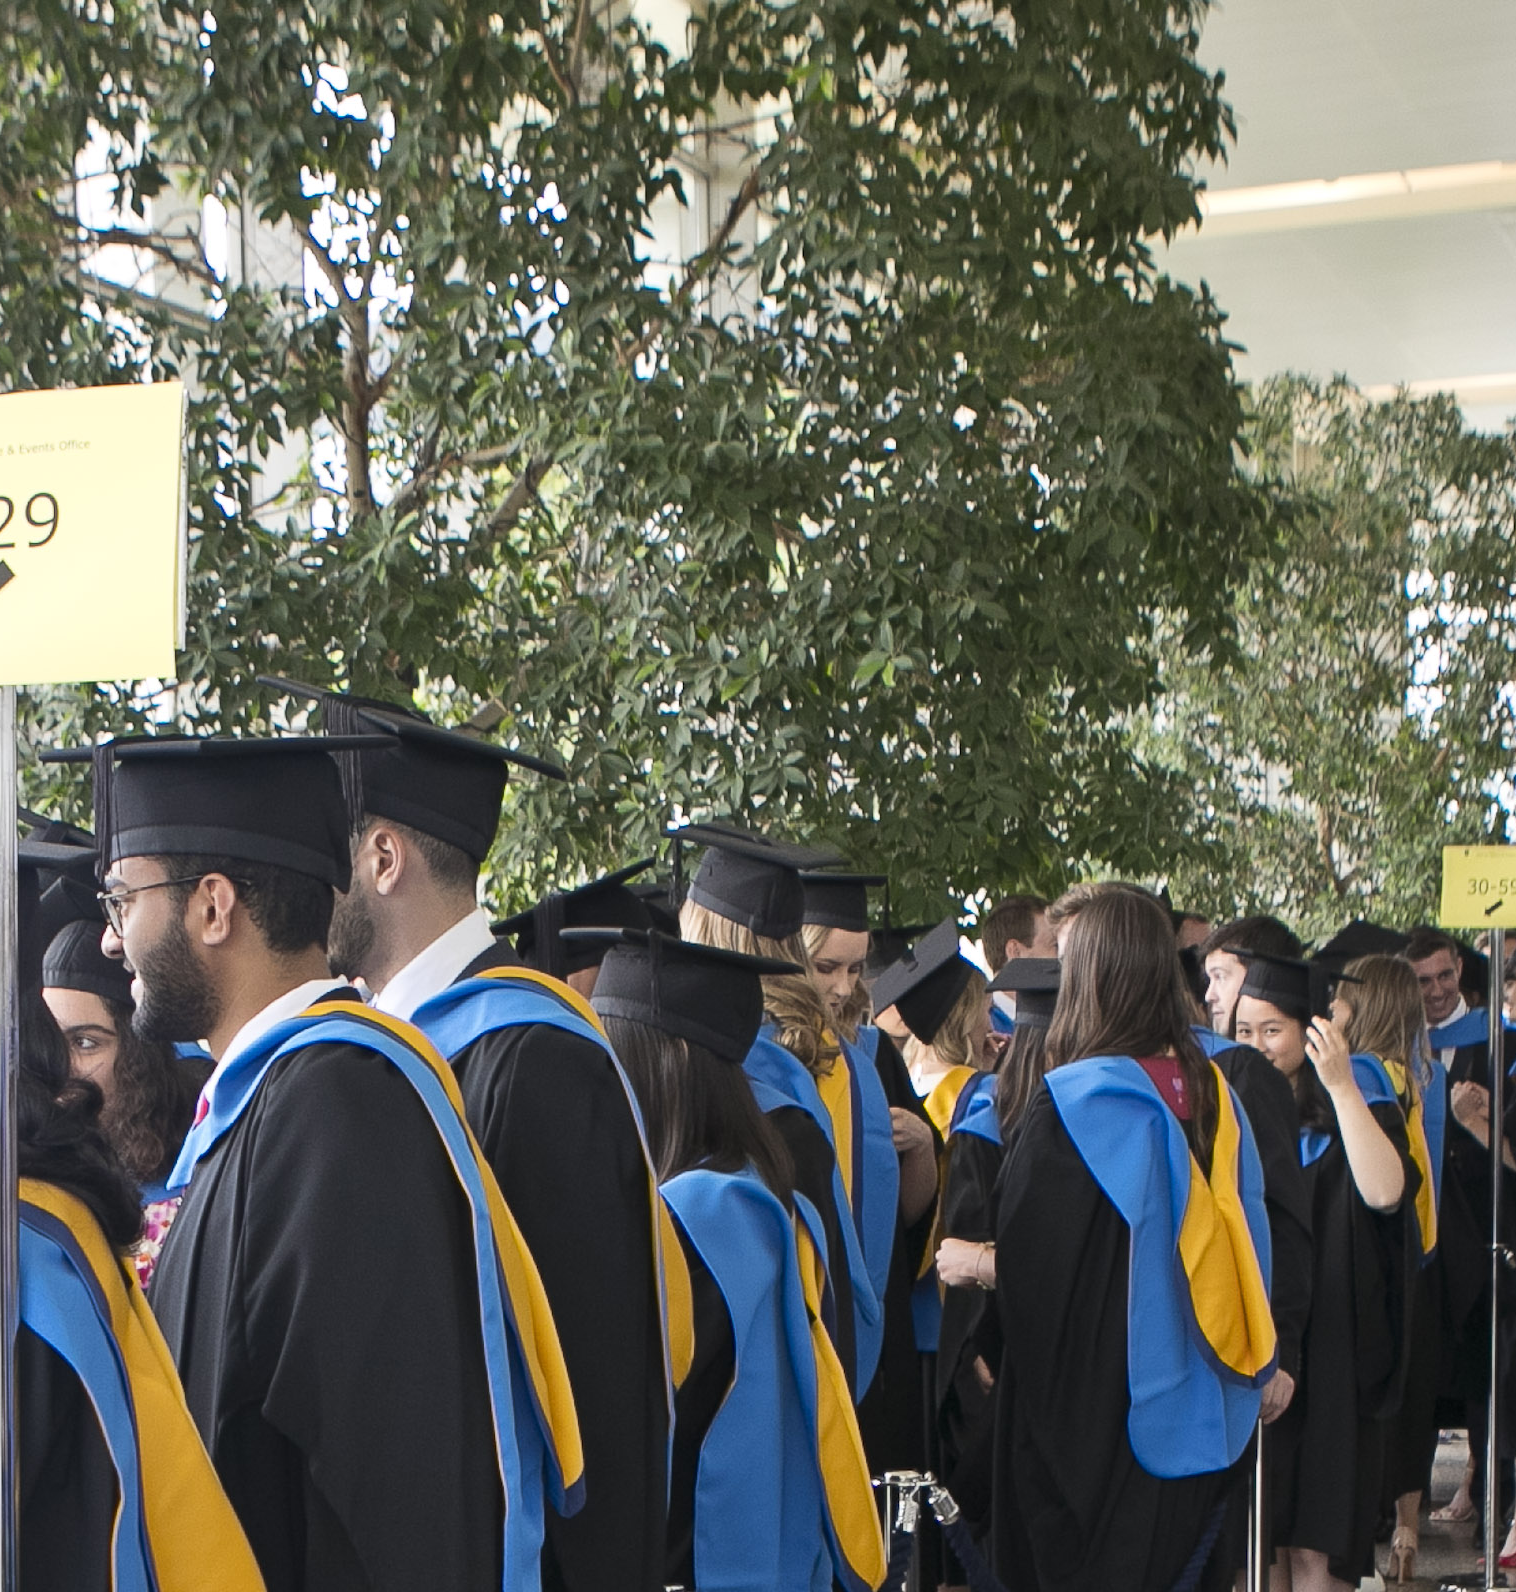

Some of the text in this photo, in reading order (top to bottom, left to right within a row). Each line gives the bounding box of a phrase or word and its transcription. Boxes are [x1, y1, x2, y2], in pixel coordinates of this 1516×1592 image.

[7, 445, 15, 455] &
[18, 441, 55, 455] Events
[59, 438, 91, 452] Office
